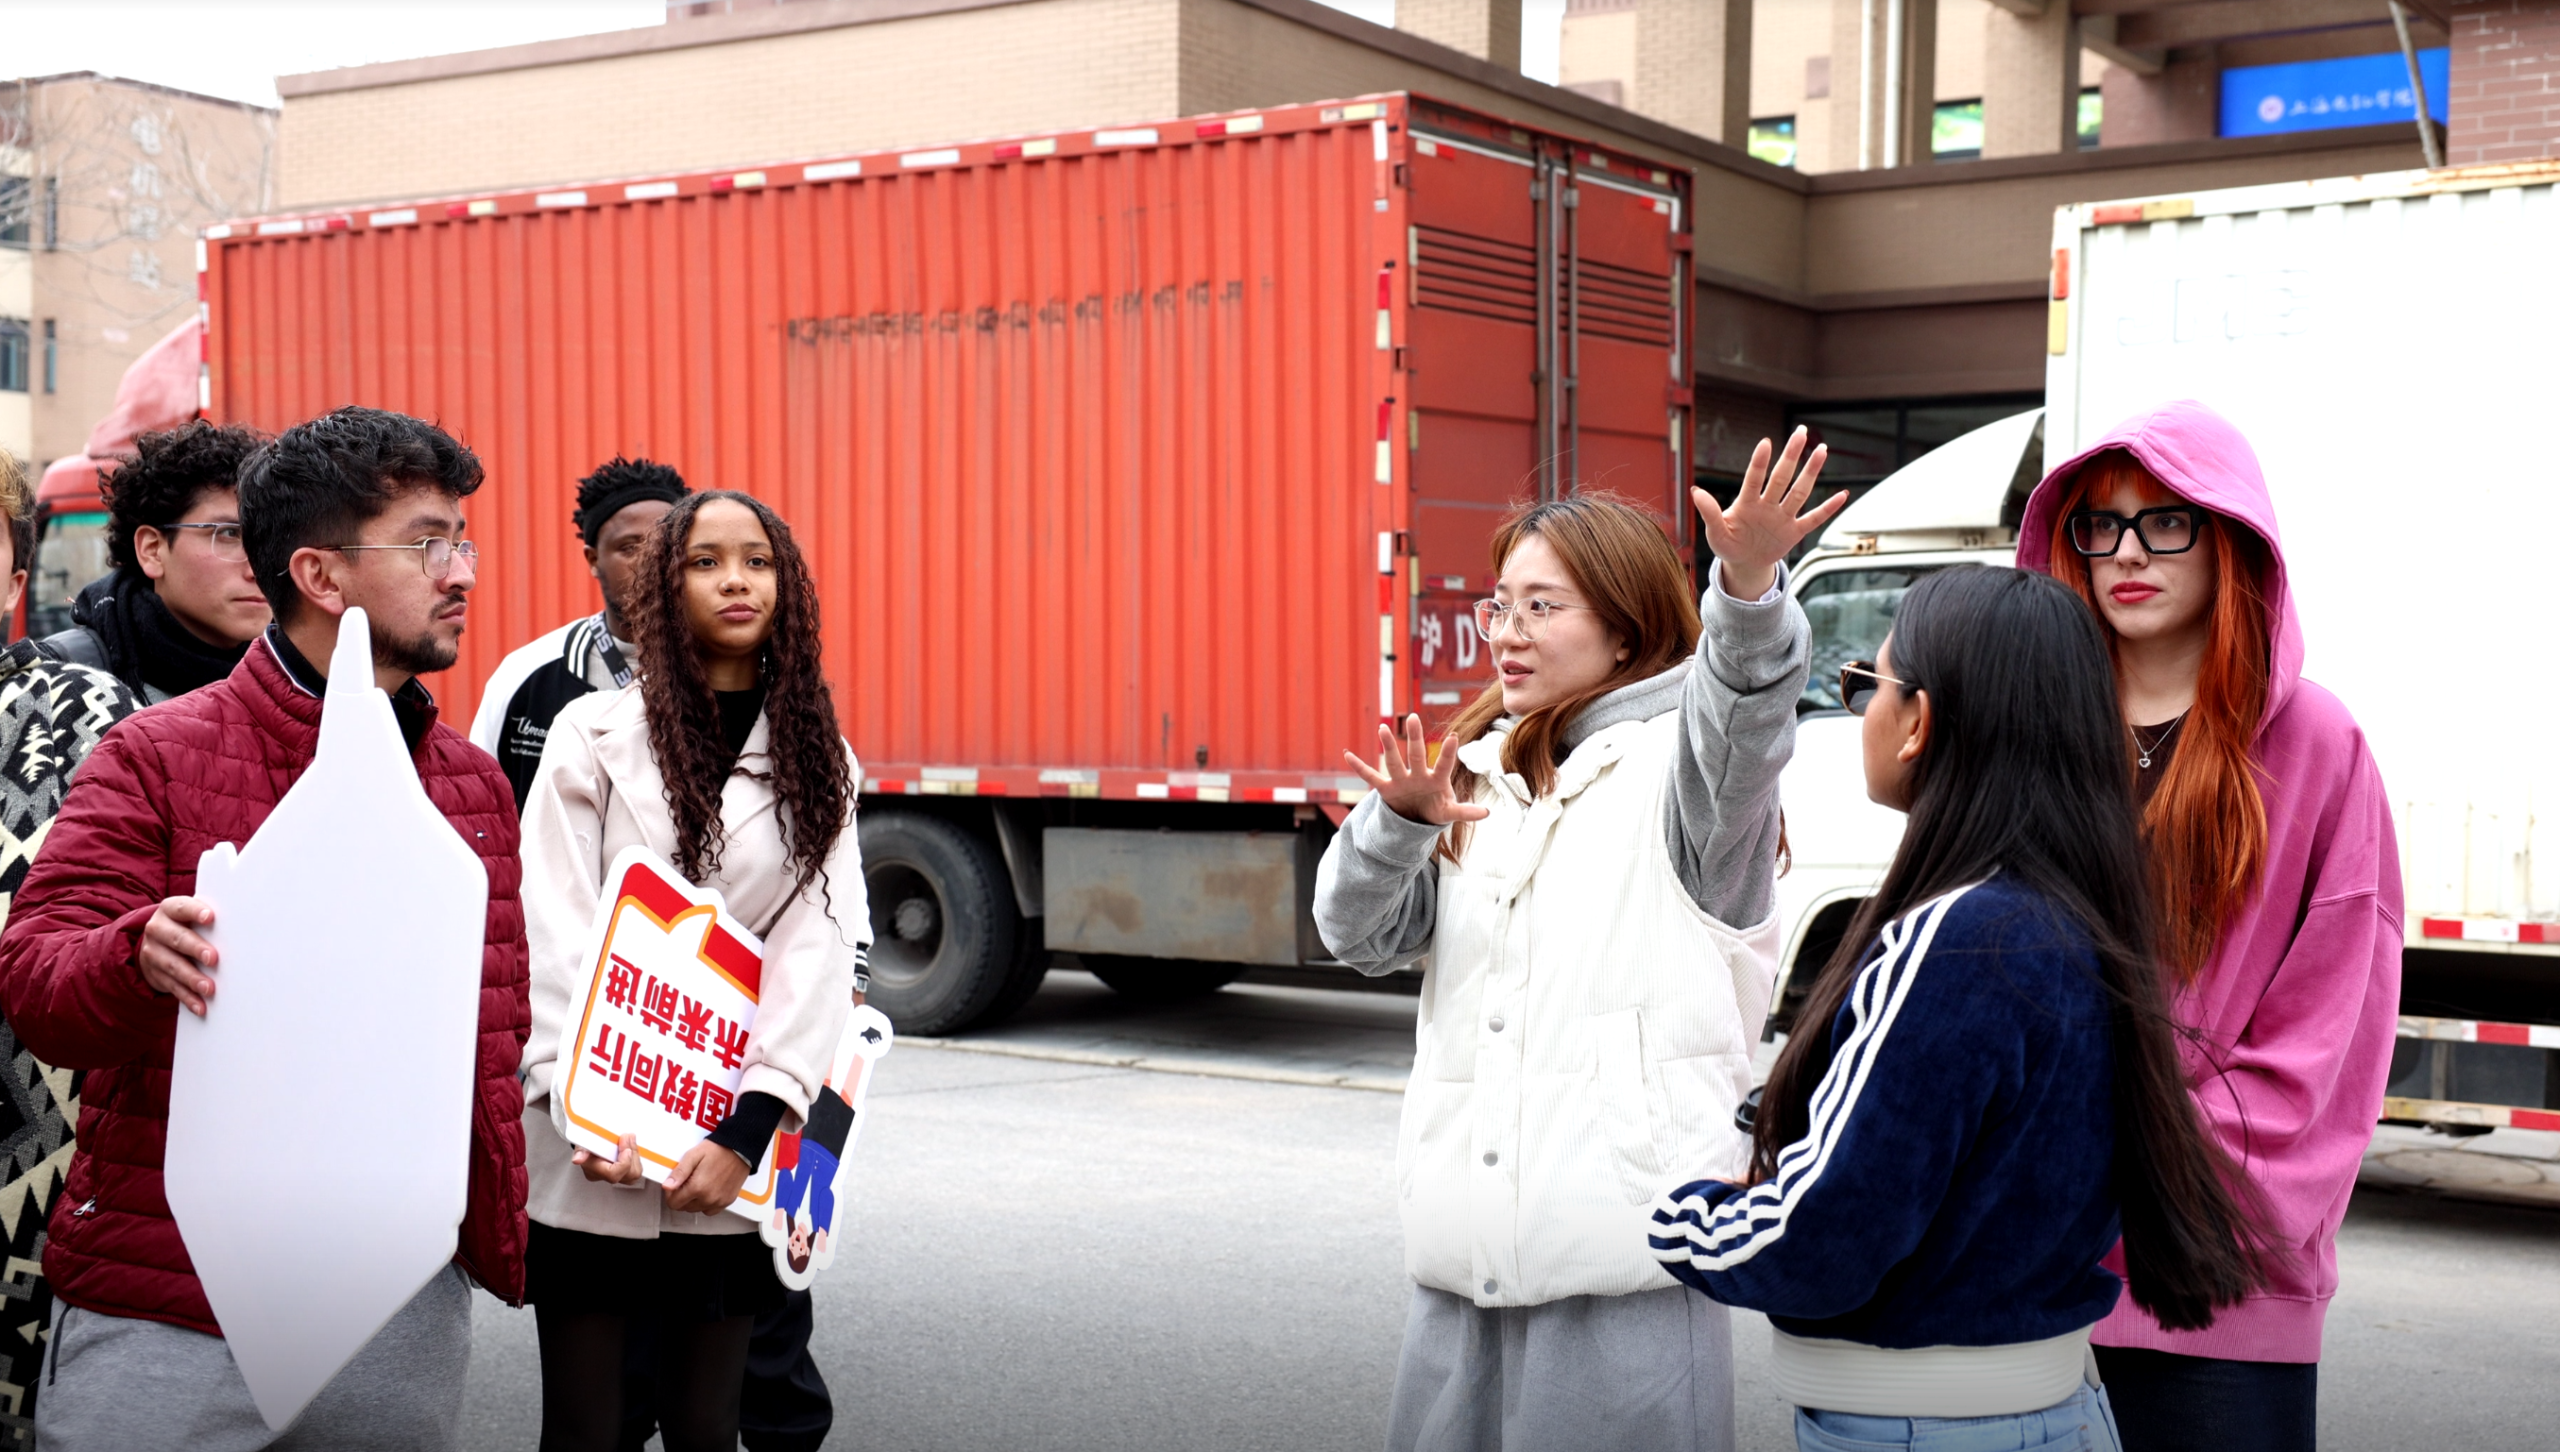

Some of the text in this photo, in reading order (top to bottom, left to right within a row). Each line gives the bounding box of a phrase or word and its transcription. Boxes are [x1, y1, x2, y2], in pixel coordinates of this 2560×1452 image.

[2117, 268, 2311, 348] JMC
[605, 952, 750, 1070] 未来前进
[589, 1023, 735, 1133] 国教同行
